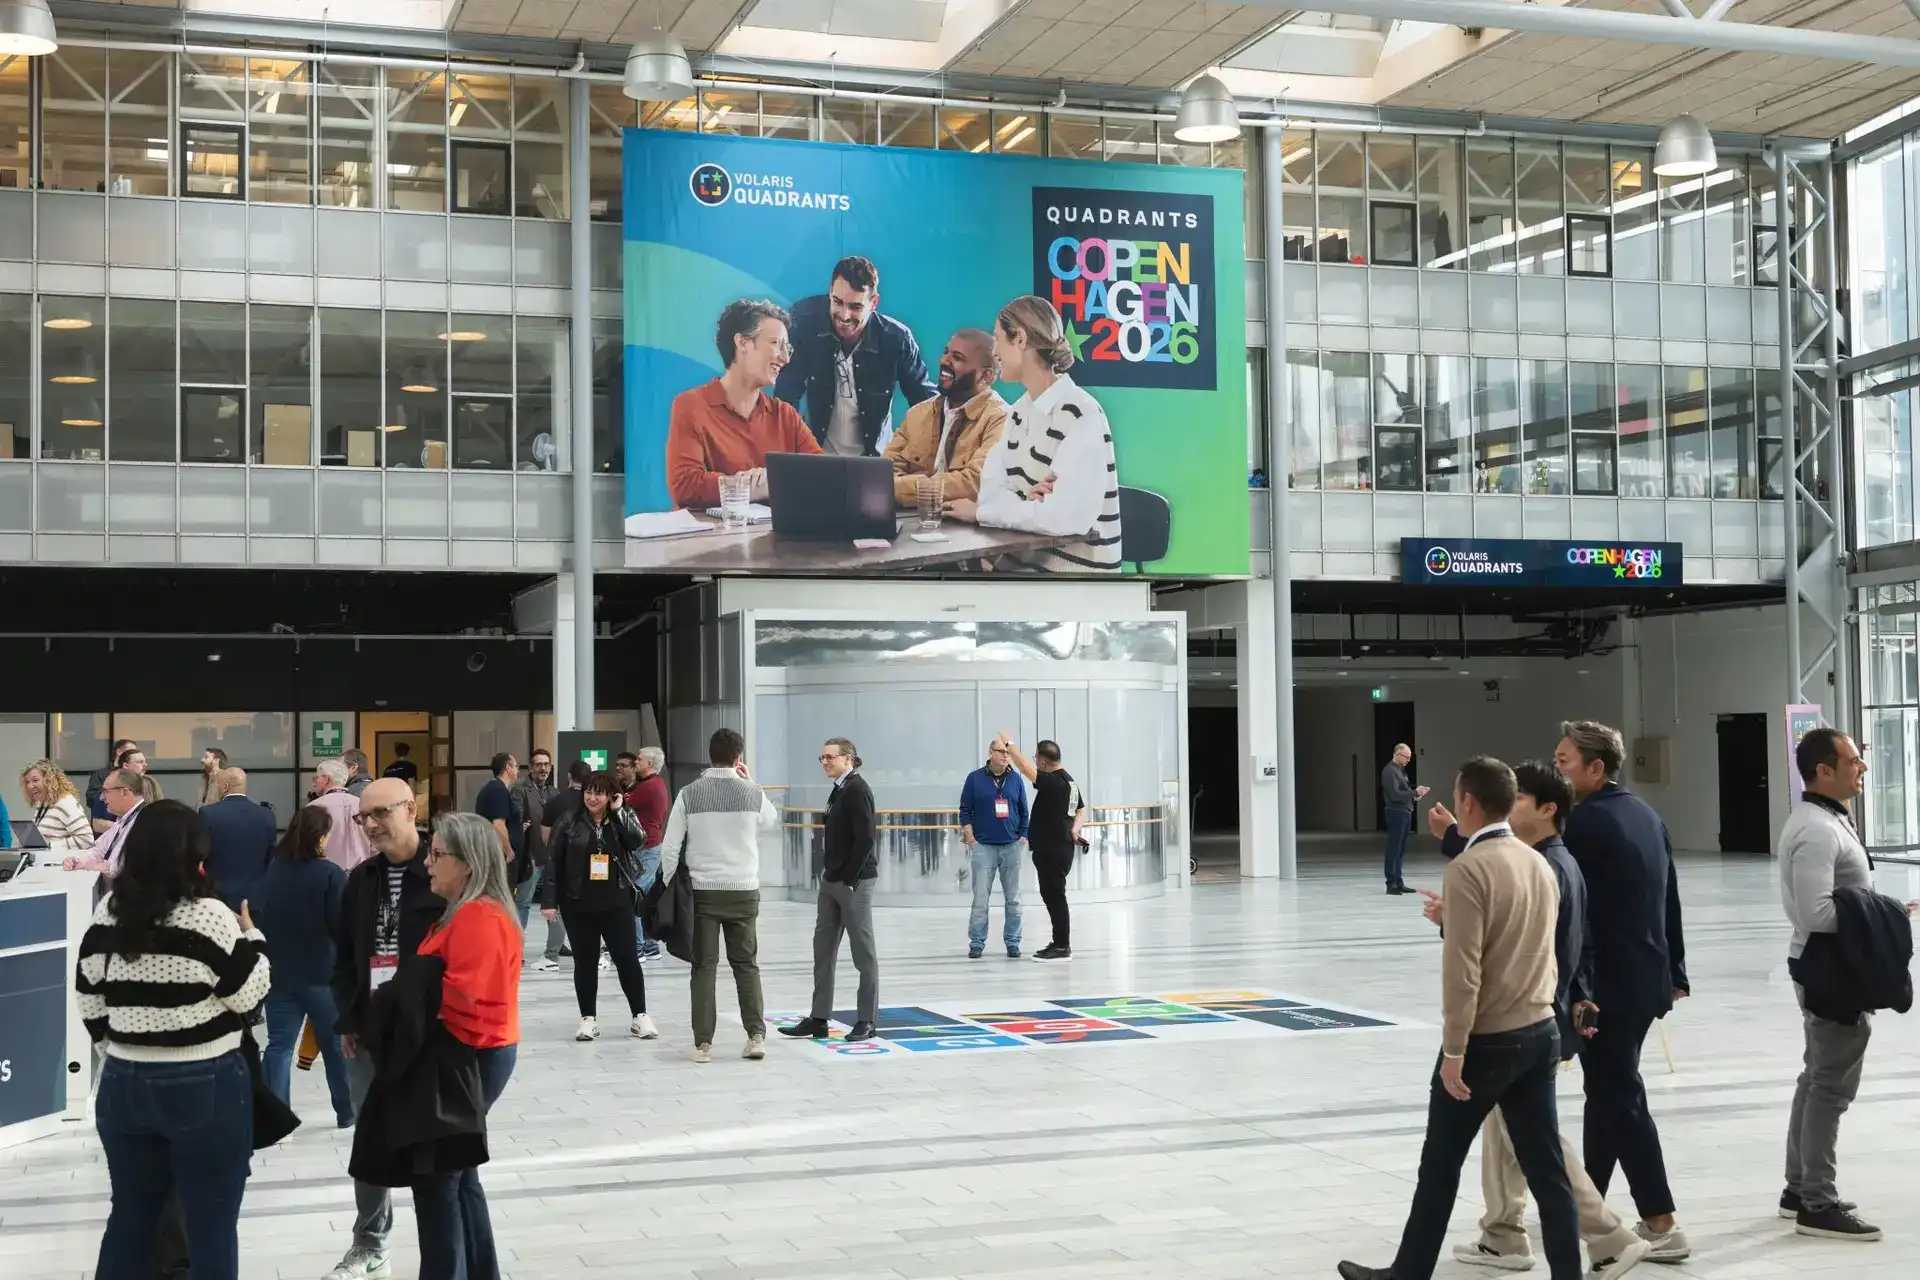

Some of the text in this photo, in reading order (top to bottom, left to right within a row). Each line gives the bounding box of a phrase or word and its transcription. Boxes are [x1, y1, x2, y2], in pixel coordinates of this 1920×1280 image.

[734, 172, 794, 189] VOLARIS
[734, 188, 850, 211] QUADRANTS
[1046, 206, 1198, 229] QUADRANTS
[1047, 236, 1190, 285] COPEN
[1051, 278, 1199, 326] HAGEN
[1091, 318, 1199, 364] 2026
[1452, 551, 1488, 562] VOLARIS
[1566, 547, 1662, 566] COPENHAGEN
[1452, 562, 1524, 574] QUADRANTS
[1625, 563, 1662, 579] 2026
